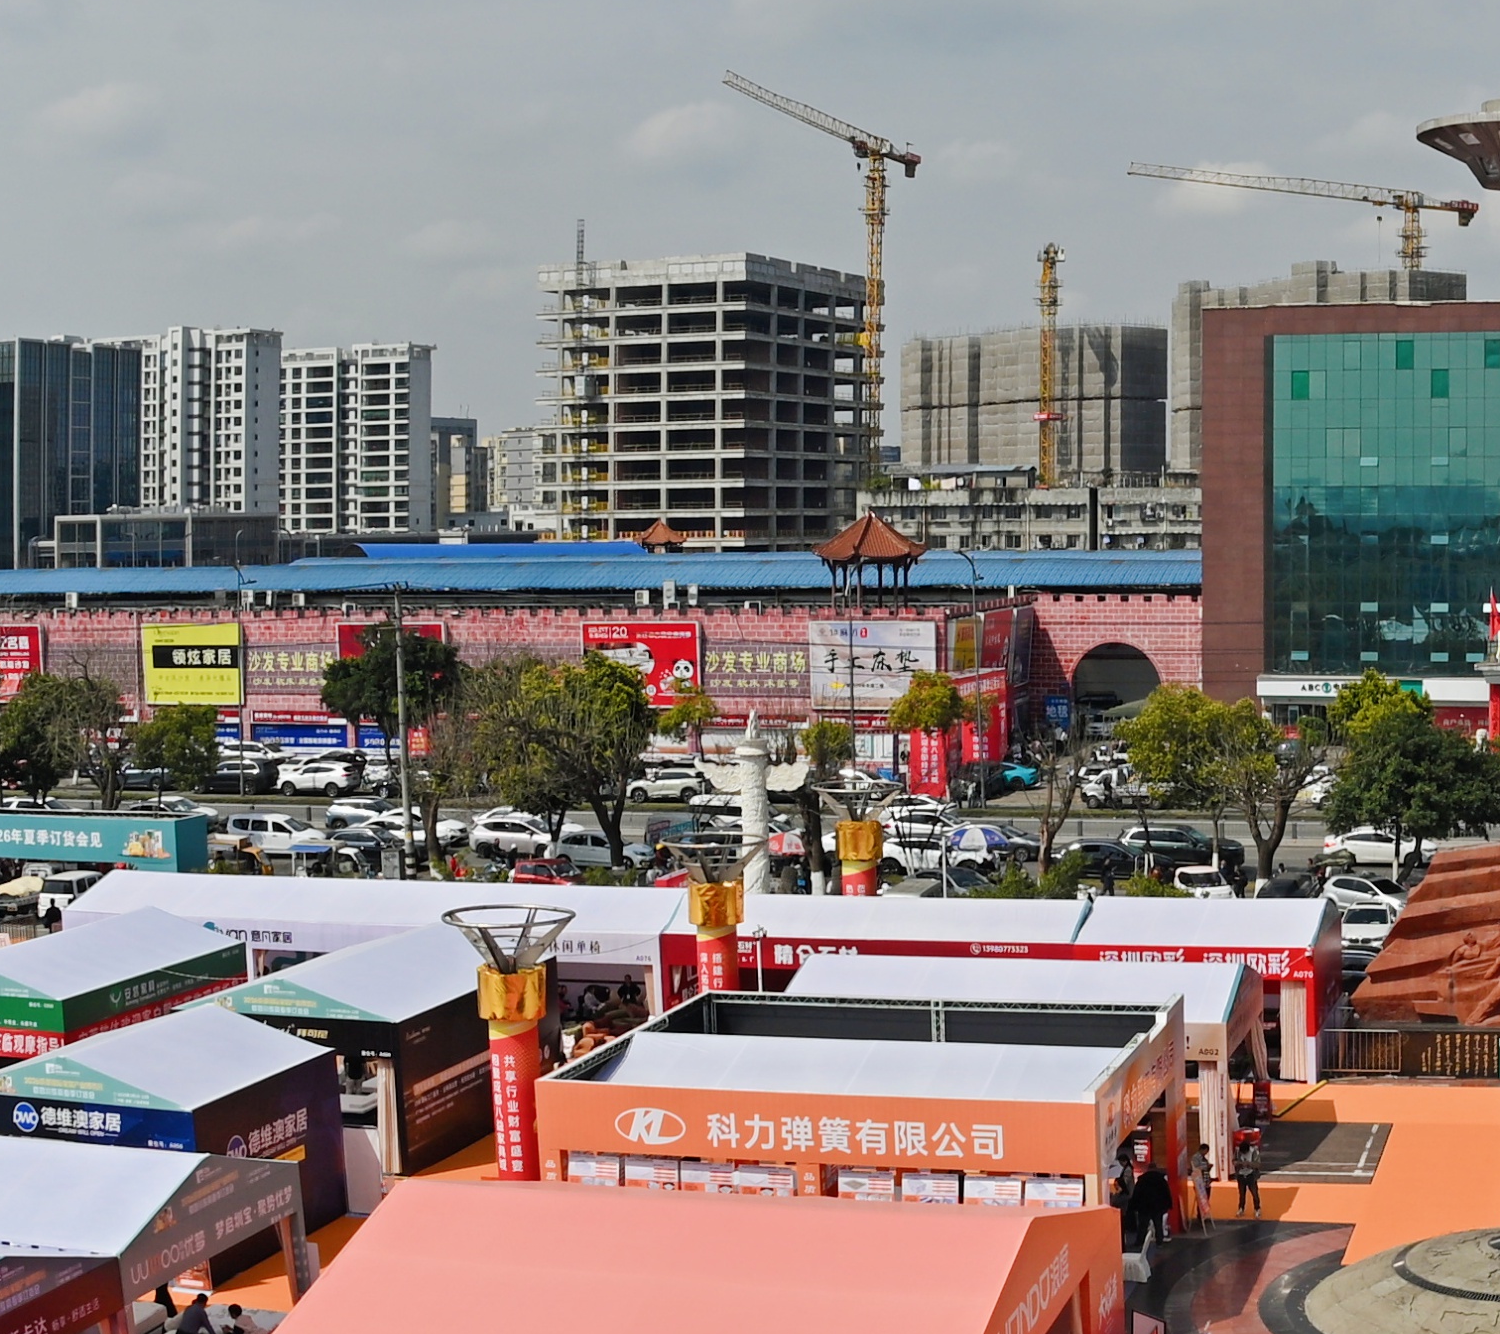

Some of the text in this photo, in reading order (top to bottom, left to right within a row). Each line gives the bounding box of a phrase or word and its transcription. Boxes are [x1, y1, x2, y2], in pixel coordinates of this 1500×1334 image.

[705, 651, 803, 675] 沙发专业商场
[41, 1106, 122, 1133] 德维澳家居
[246, 1106, 308, 1145] 德维澳家居
[503, 1053, 524, 1173] 共享行业财富盛宴
[705, 1113, 1004, 1161] 科力弹簧有限公司
